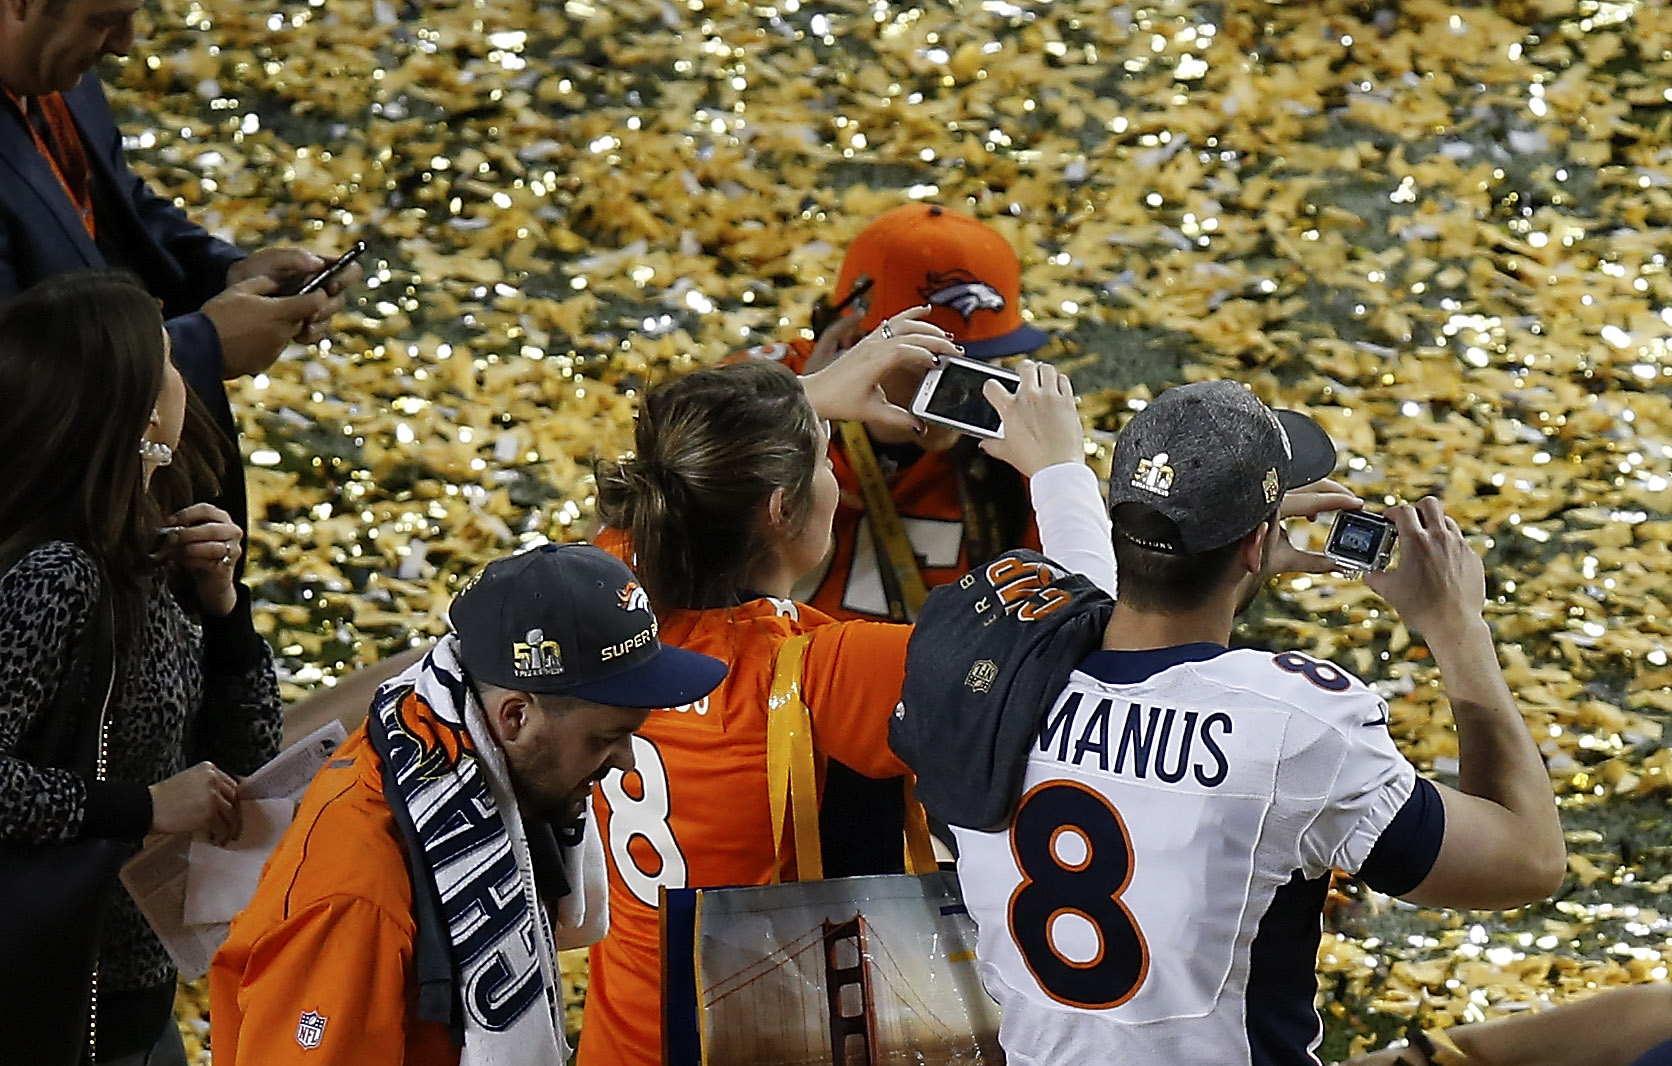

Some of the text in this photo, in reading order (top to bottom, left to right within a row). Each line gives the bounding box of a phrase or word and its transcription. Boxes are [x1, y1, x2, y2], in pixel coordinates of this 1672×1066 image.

[601, 630, 651, 661] SUPER
[1272, 651, 1352, 692] 8
[1007, 779, 1150, 1010] 8
[299, 1026, 320, 1044] NFL
